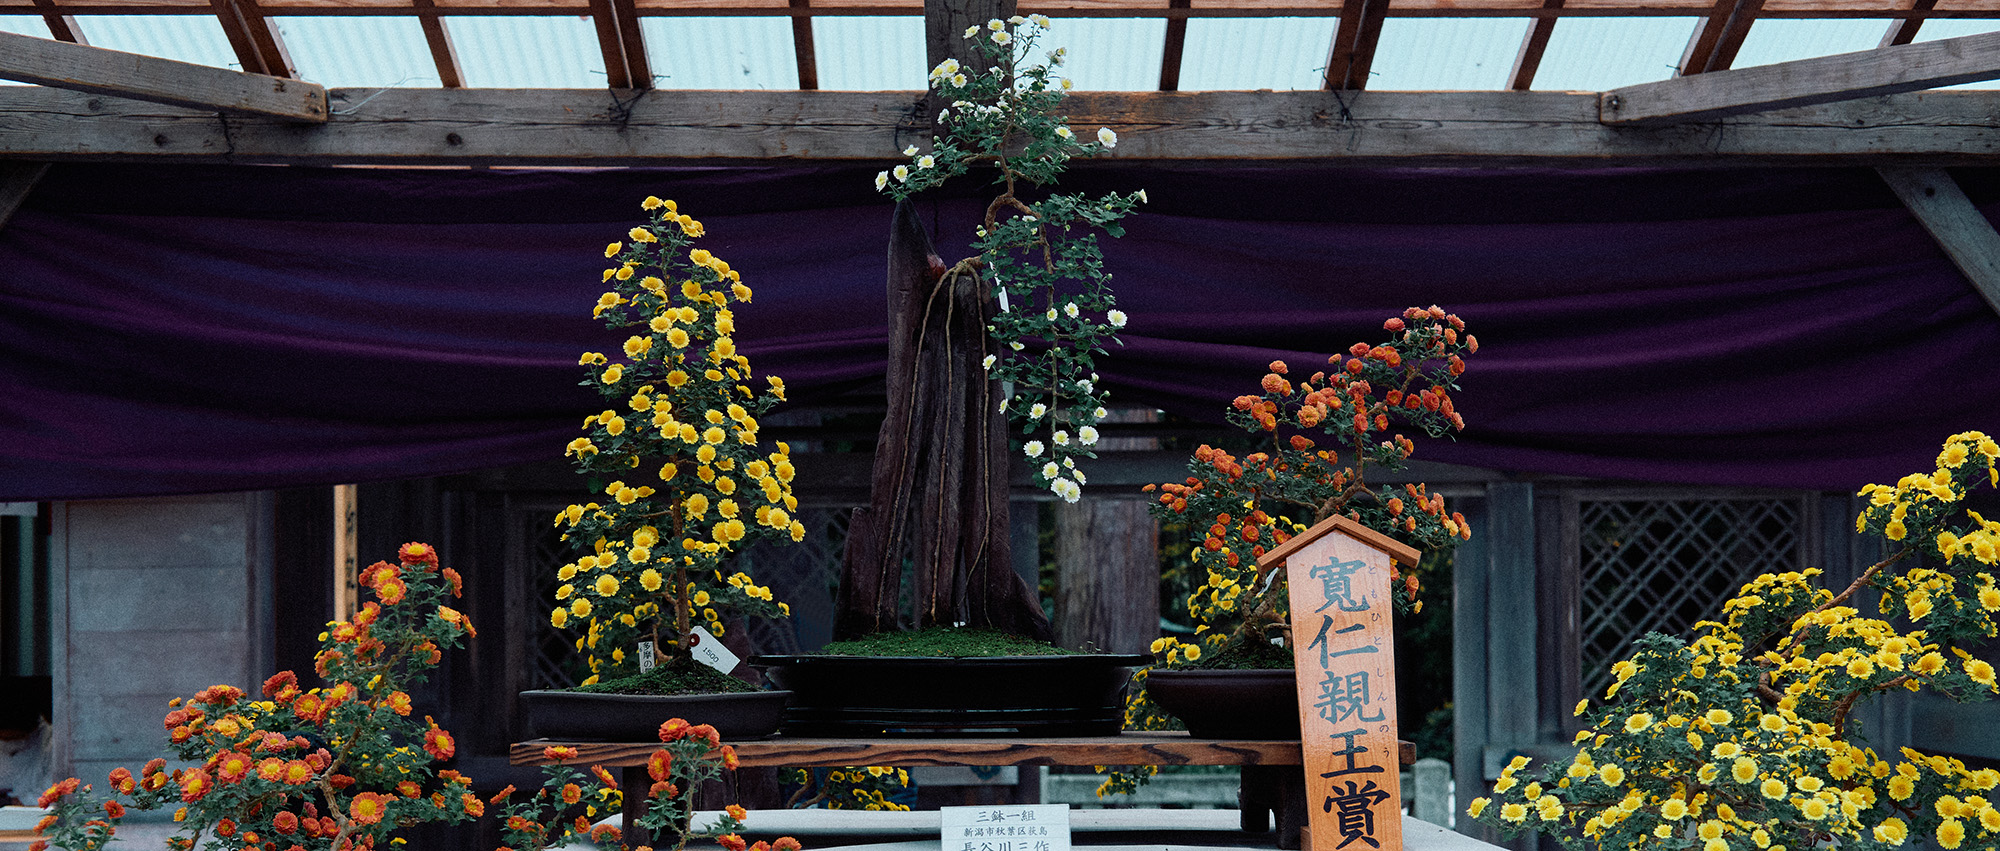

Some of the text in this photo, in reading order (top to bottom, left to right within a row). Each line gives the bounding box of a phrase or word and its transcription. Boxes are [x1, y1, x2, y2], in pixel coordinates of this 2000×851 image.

[643, 642, 653, 671] 多摩の
[702, 647, 720, 663] 1500
[976, 810, 1036, 823] 三鉢一組
